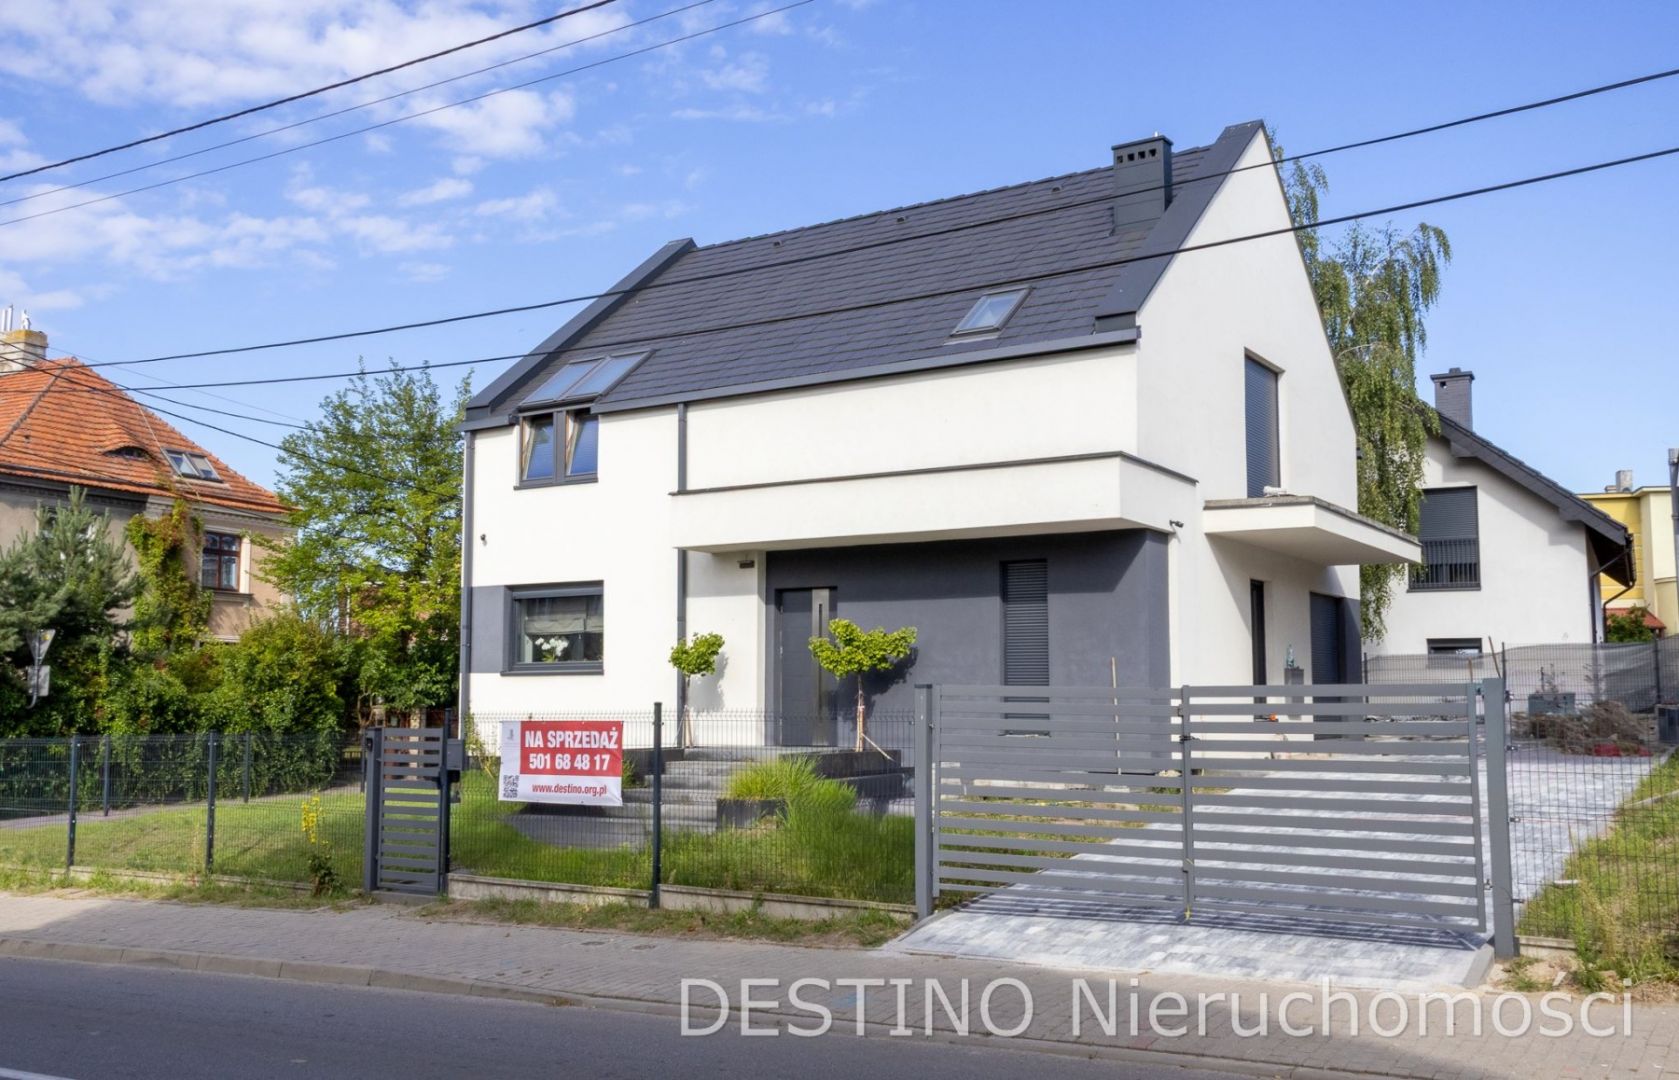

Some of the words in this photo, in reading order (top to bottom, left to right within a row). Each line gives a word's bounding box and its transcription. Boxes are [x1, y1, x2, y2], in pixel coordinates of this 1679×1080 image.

[525, 730, 544, 748] NA
[547, 727, 618, 749] SPRZEDAŻ
[529, 753, 551, 769] 501
[555, 753, 571, 770] 68
[574, 754, 590, 770] 48
[594, 754, 610, 771] 17
[532, 783, 607, 797] www.destino.org.pl
